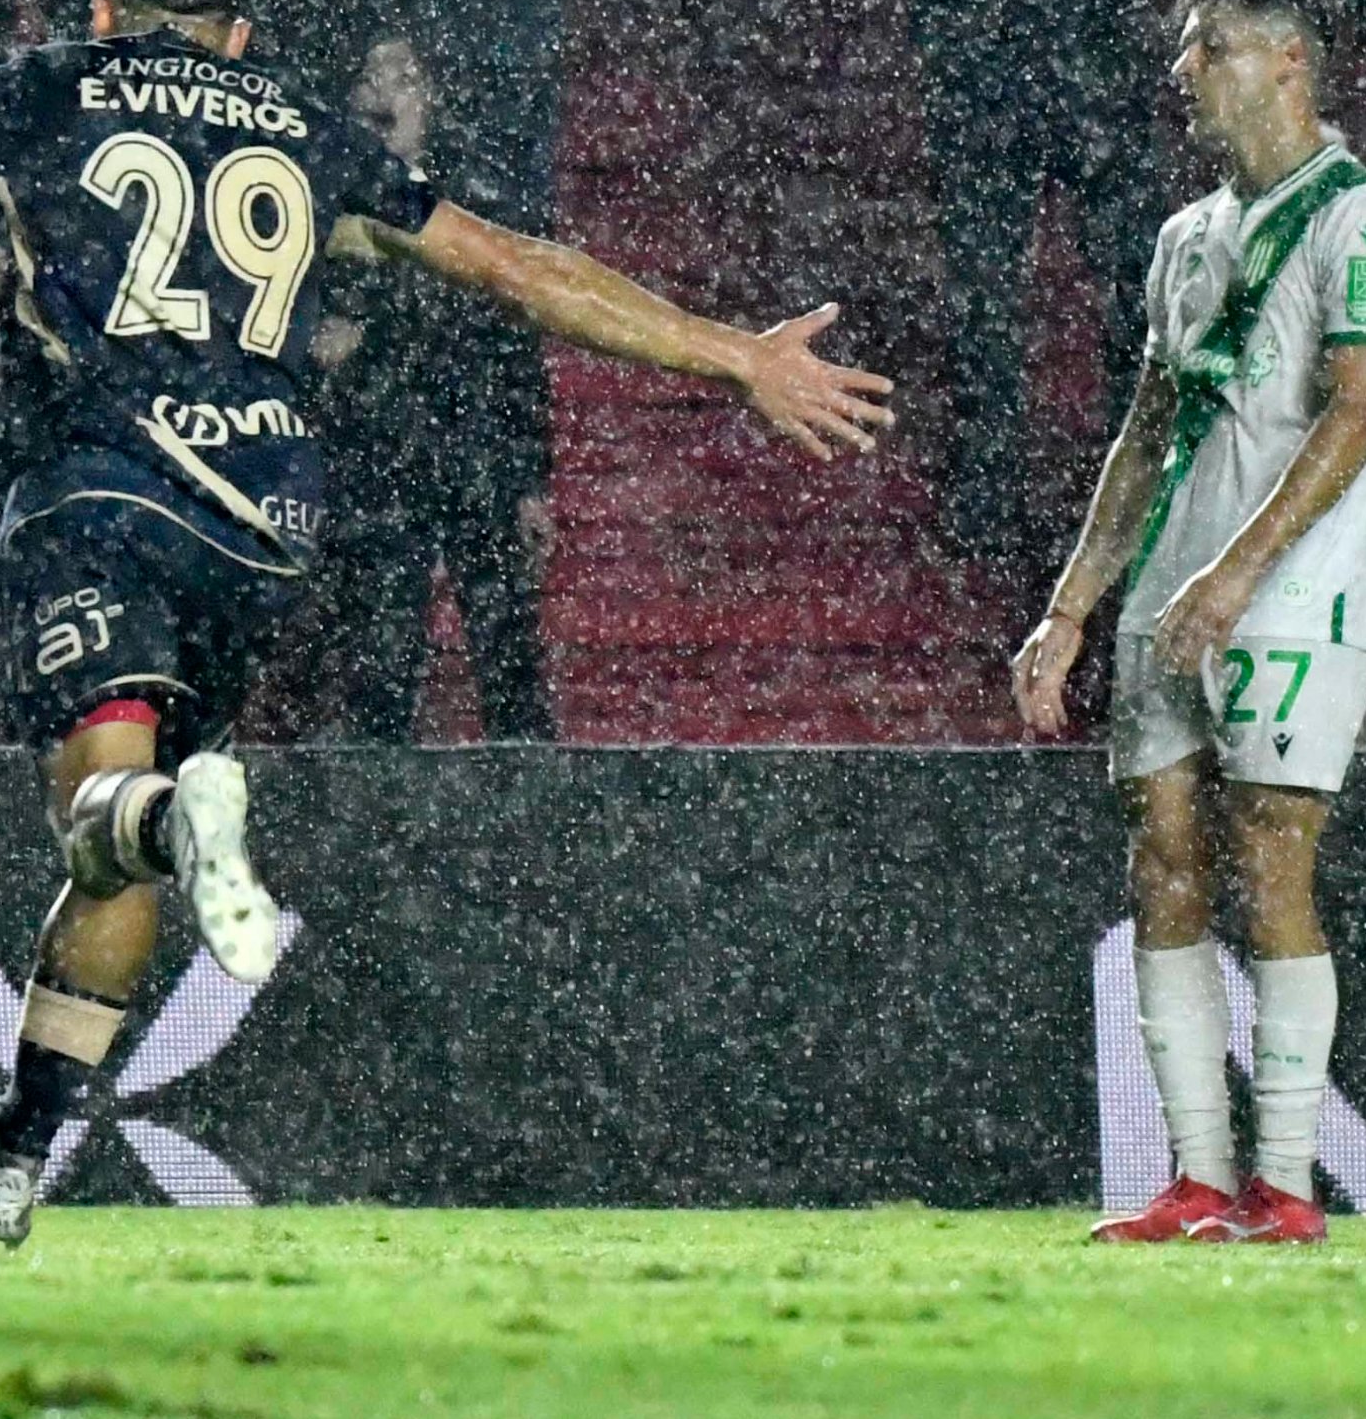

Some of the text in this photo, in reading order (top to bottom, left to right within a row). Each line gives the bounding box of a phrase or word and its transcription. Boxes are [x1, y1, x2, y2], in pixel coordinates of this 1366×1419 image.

[98, 56, 286, 103] ANGIOCOR
[79, 76, 308, 139] E.VIVEROS
[80, 131, 316, 359] 29
[260, 495, 319, 533] GEL
[35, 586, 100, 625] UPO
[1223, 648, 1311, 722] 27
